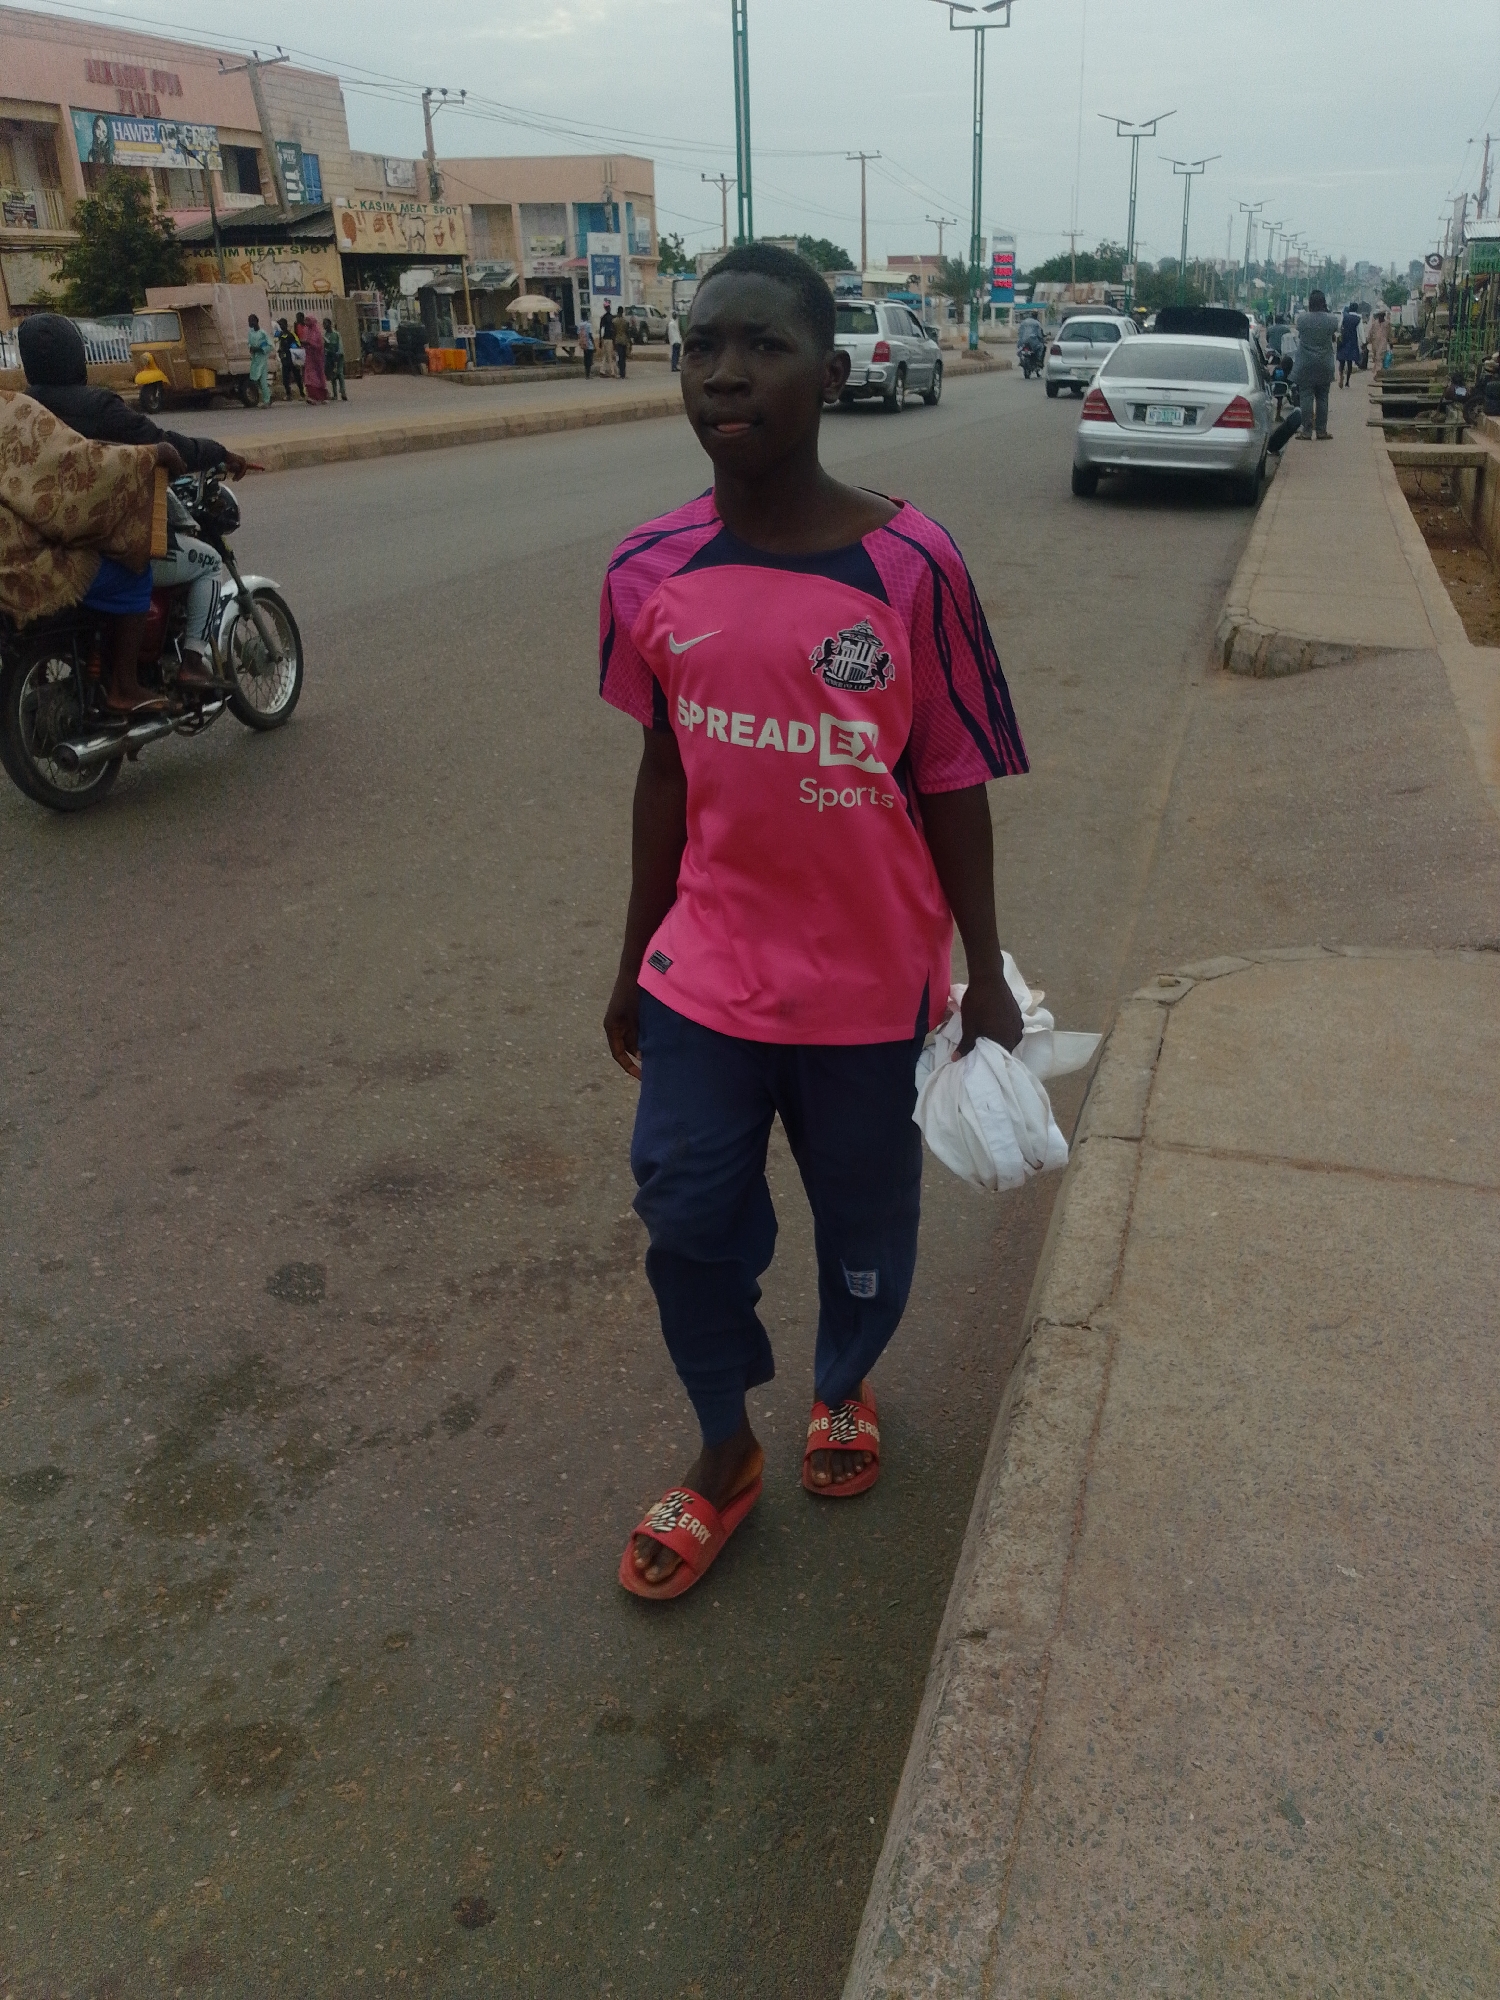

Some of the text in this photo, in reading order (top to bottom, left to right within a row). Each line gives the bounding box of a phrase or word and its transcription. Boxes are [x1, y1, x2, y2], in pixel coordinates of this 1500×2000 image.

[111, 121, 157, 143] HAWEE
[400, 203, 428, 214] MEAT
[433, 206, 457, 216] SPOT
[799, 777, 895, 813] Sports
